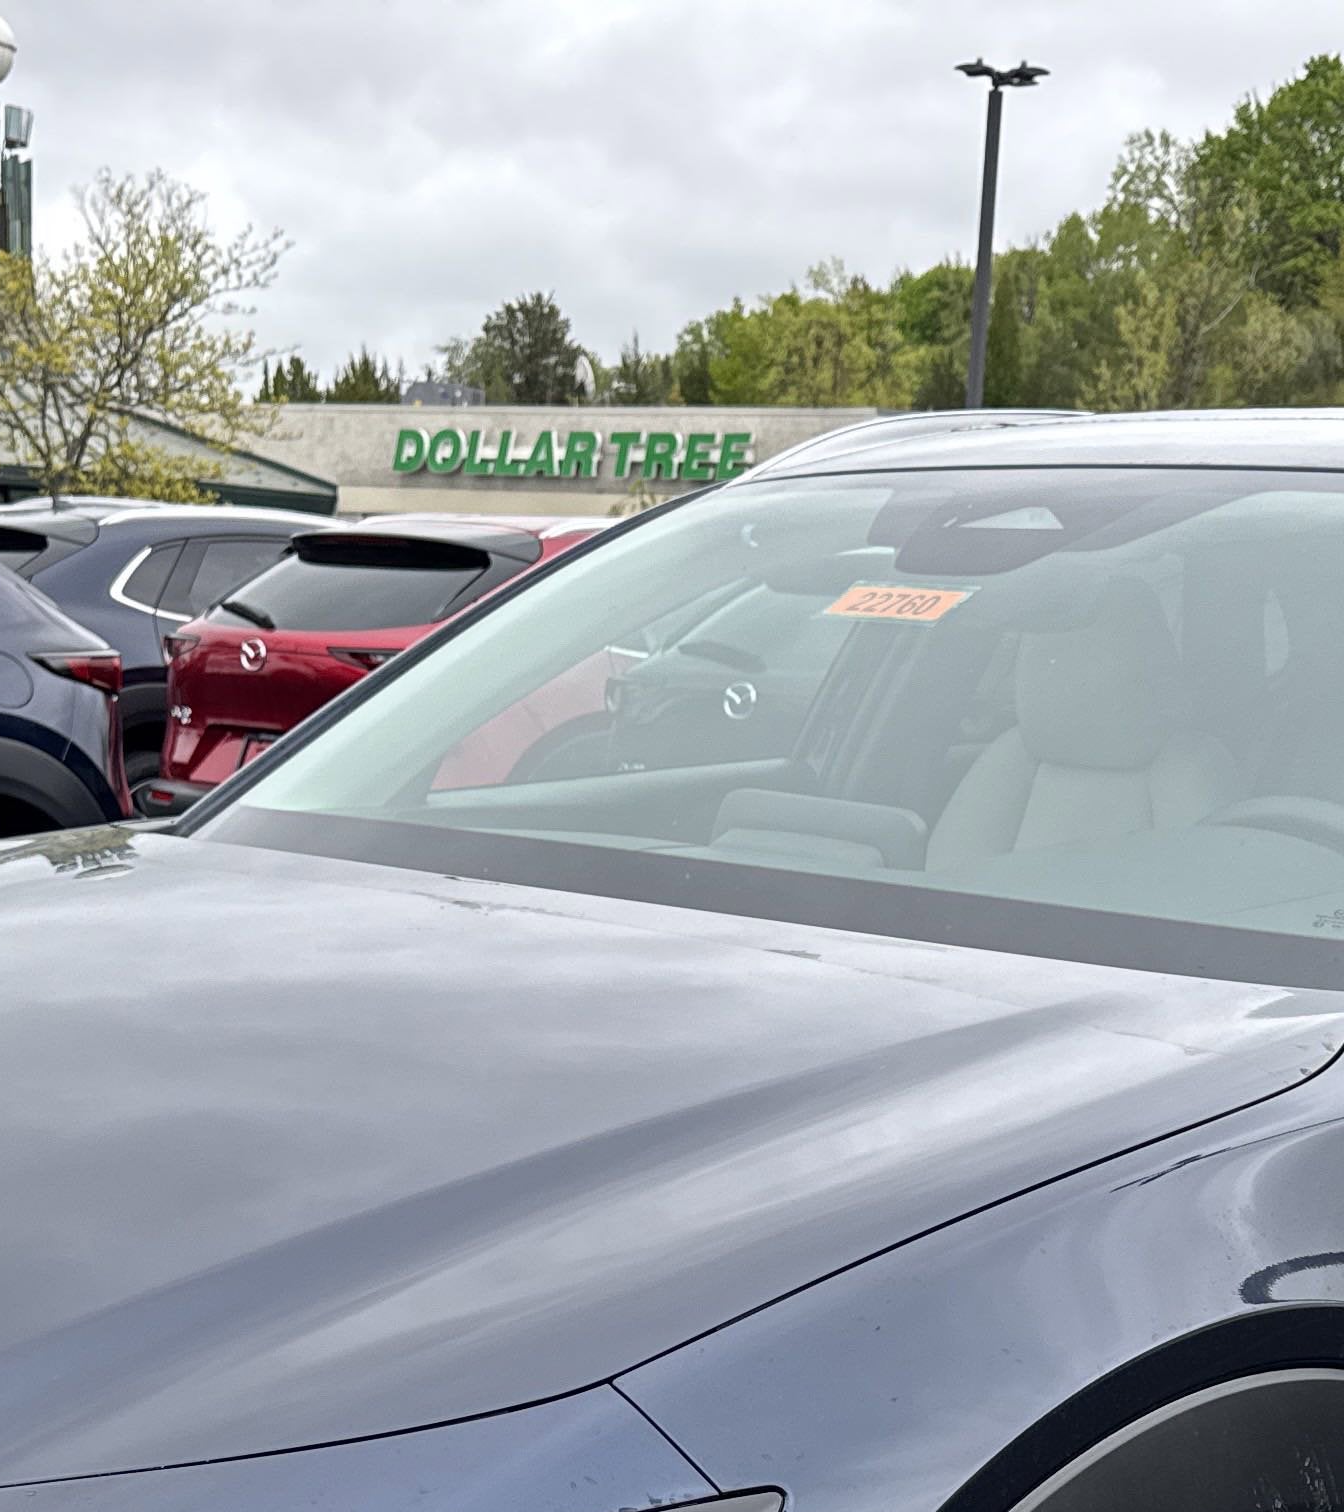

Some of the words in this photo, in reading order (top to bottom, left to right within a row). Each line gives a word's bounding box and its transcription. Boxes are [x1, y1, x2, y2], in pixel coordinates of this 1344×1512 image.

[392, 427, 600, 479] DOLLAR
[609, 431, 754, 481] TREE
[845, 591, 942, 616] 22760
